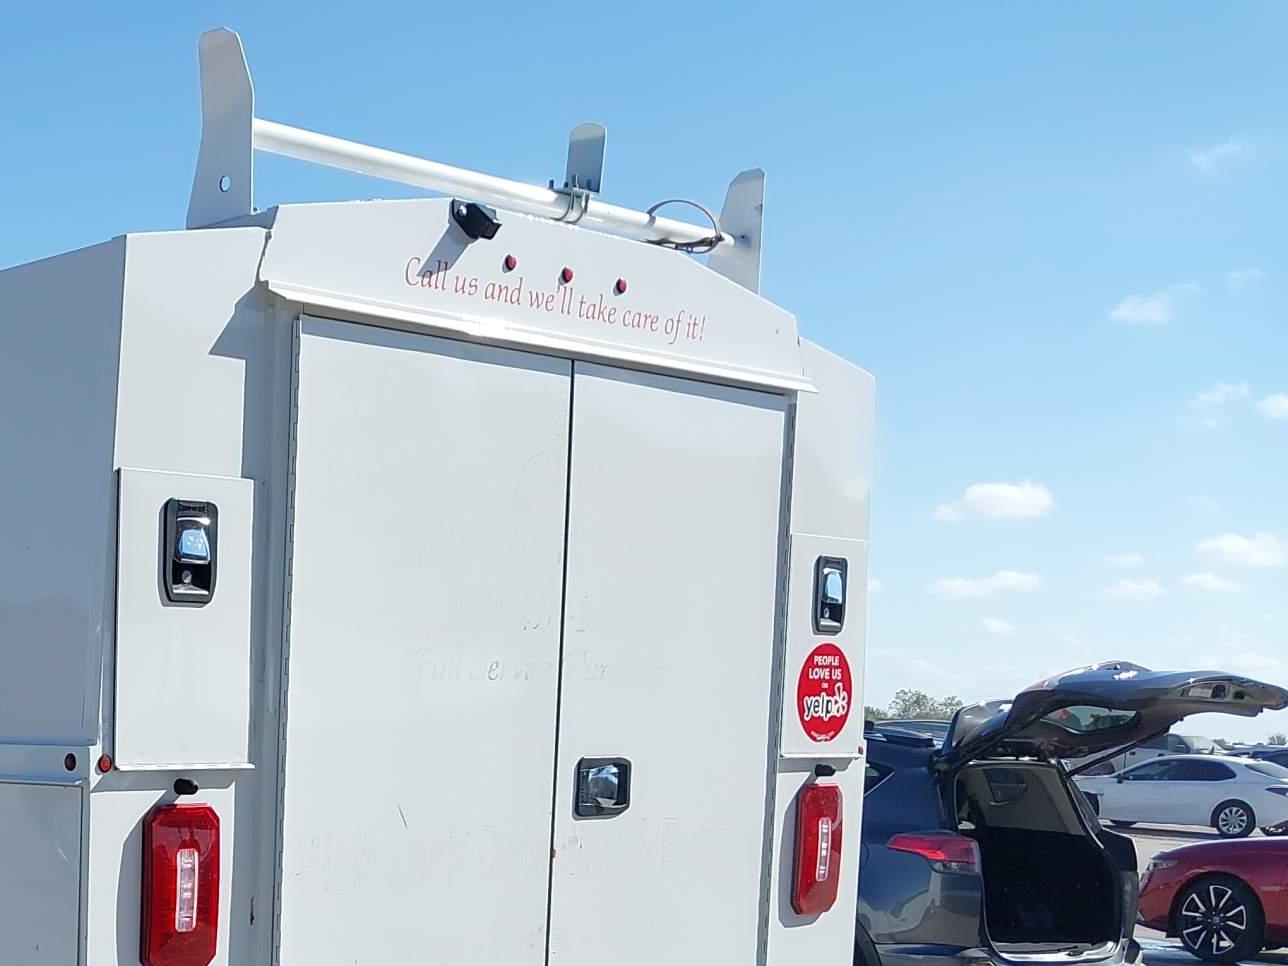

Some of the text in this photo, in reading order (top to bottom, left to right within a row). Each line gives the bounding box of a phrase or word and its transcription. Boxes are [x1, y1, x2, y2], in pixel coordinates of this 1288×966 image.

[405, 256, 707, 345] Call us and we'll take care of it!
[813, 655, 840, 666] PEOPLE
[808, 668, 842, 680] LOVE US
[803, 692, 833, 721] yelp
